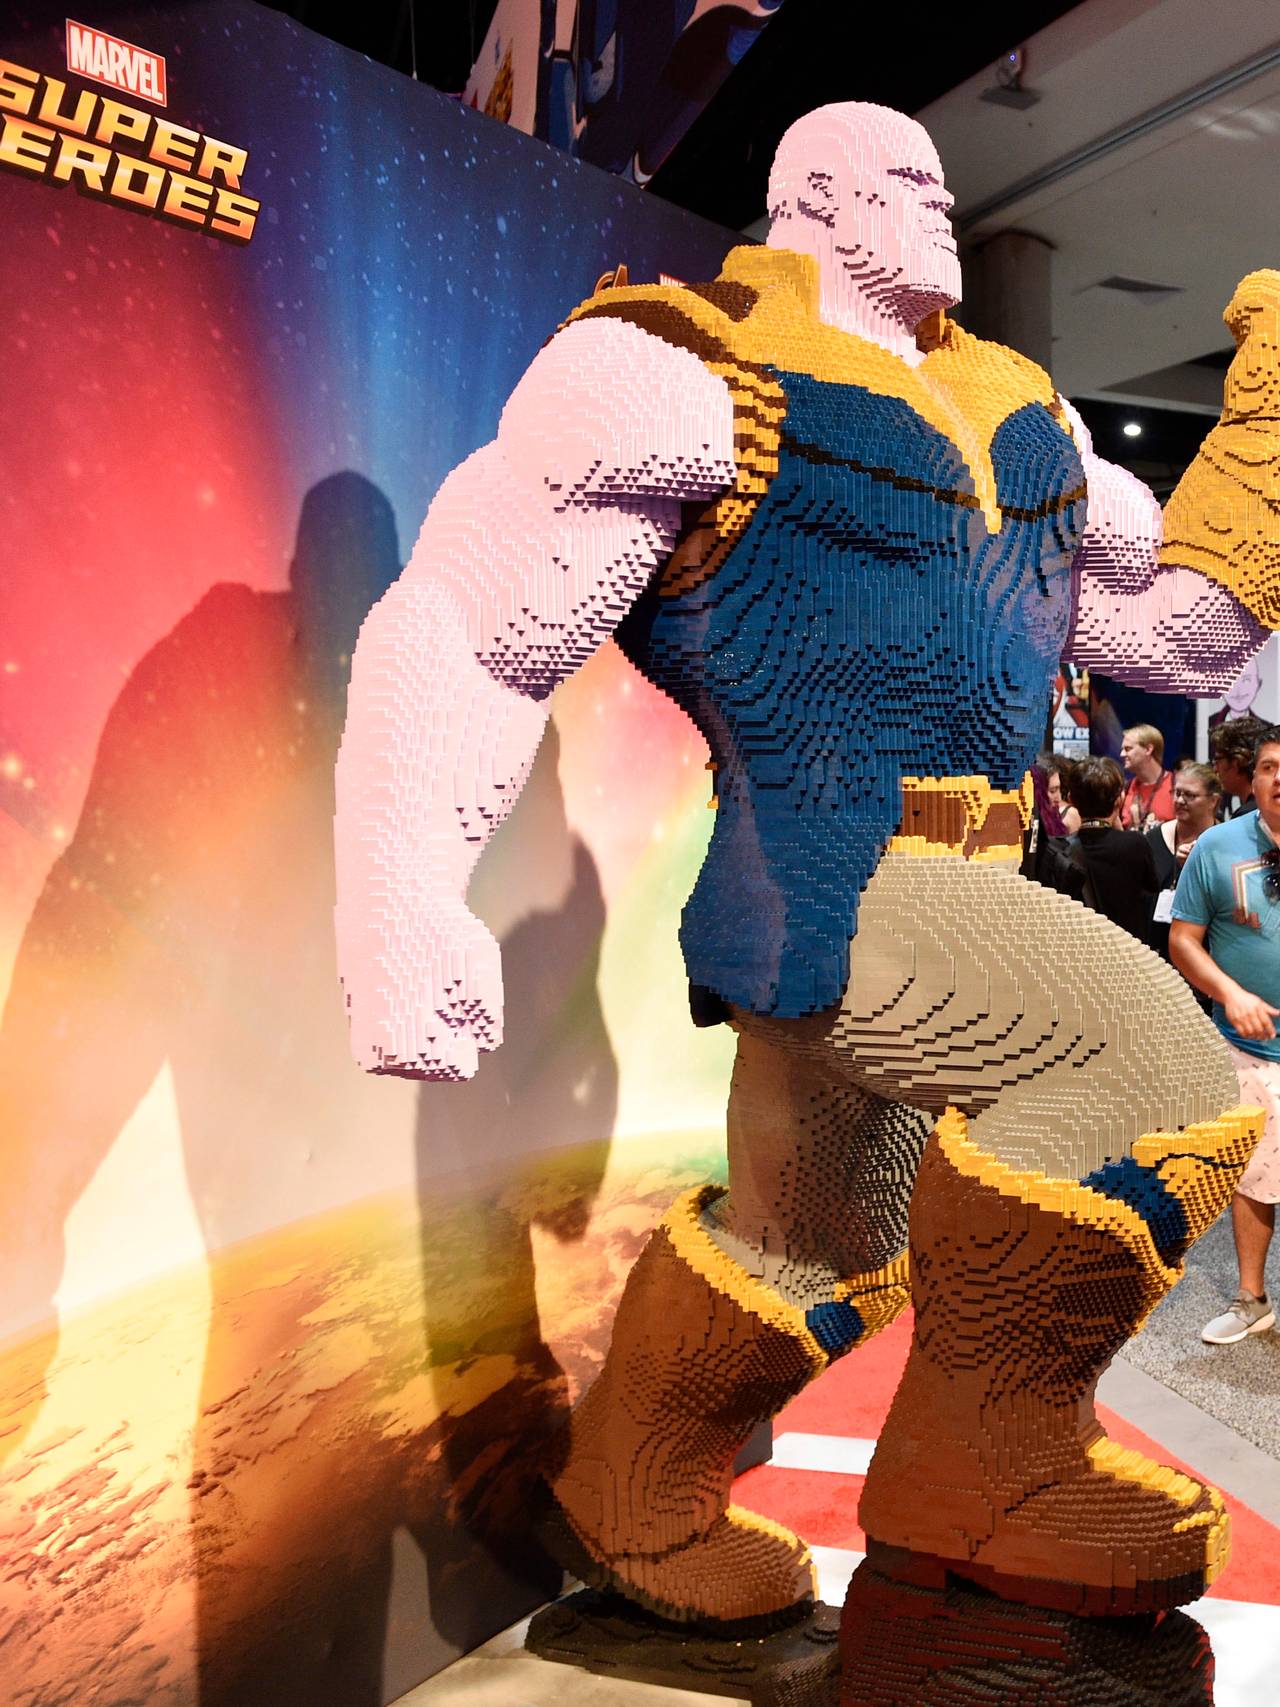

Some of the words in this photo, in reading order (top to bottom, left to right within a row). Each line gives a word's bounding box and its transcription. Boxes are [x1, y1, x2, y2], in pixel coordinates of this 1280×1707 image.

[0, 58, 248, 190] SUPER
[69, 25, 164, 101] MARVEL
[0, 112, 261, 240] EROES
